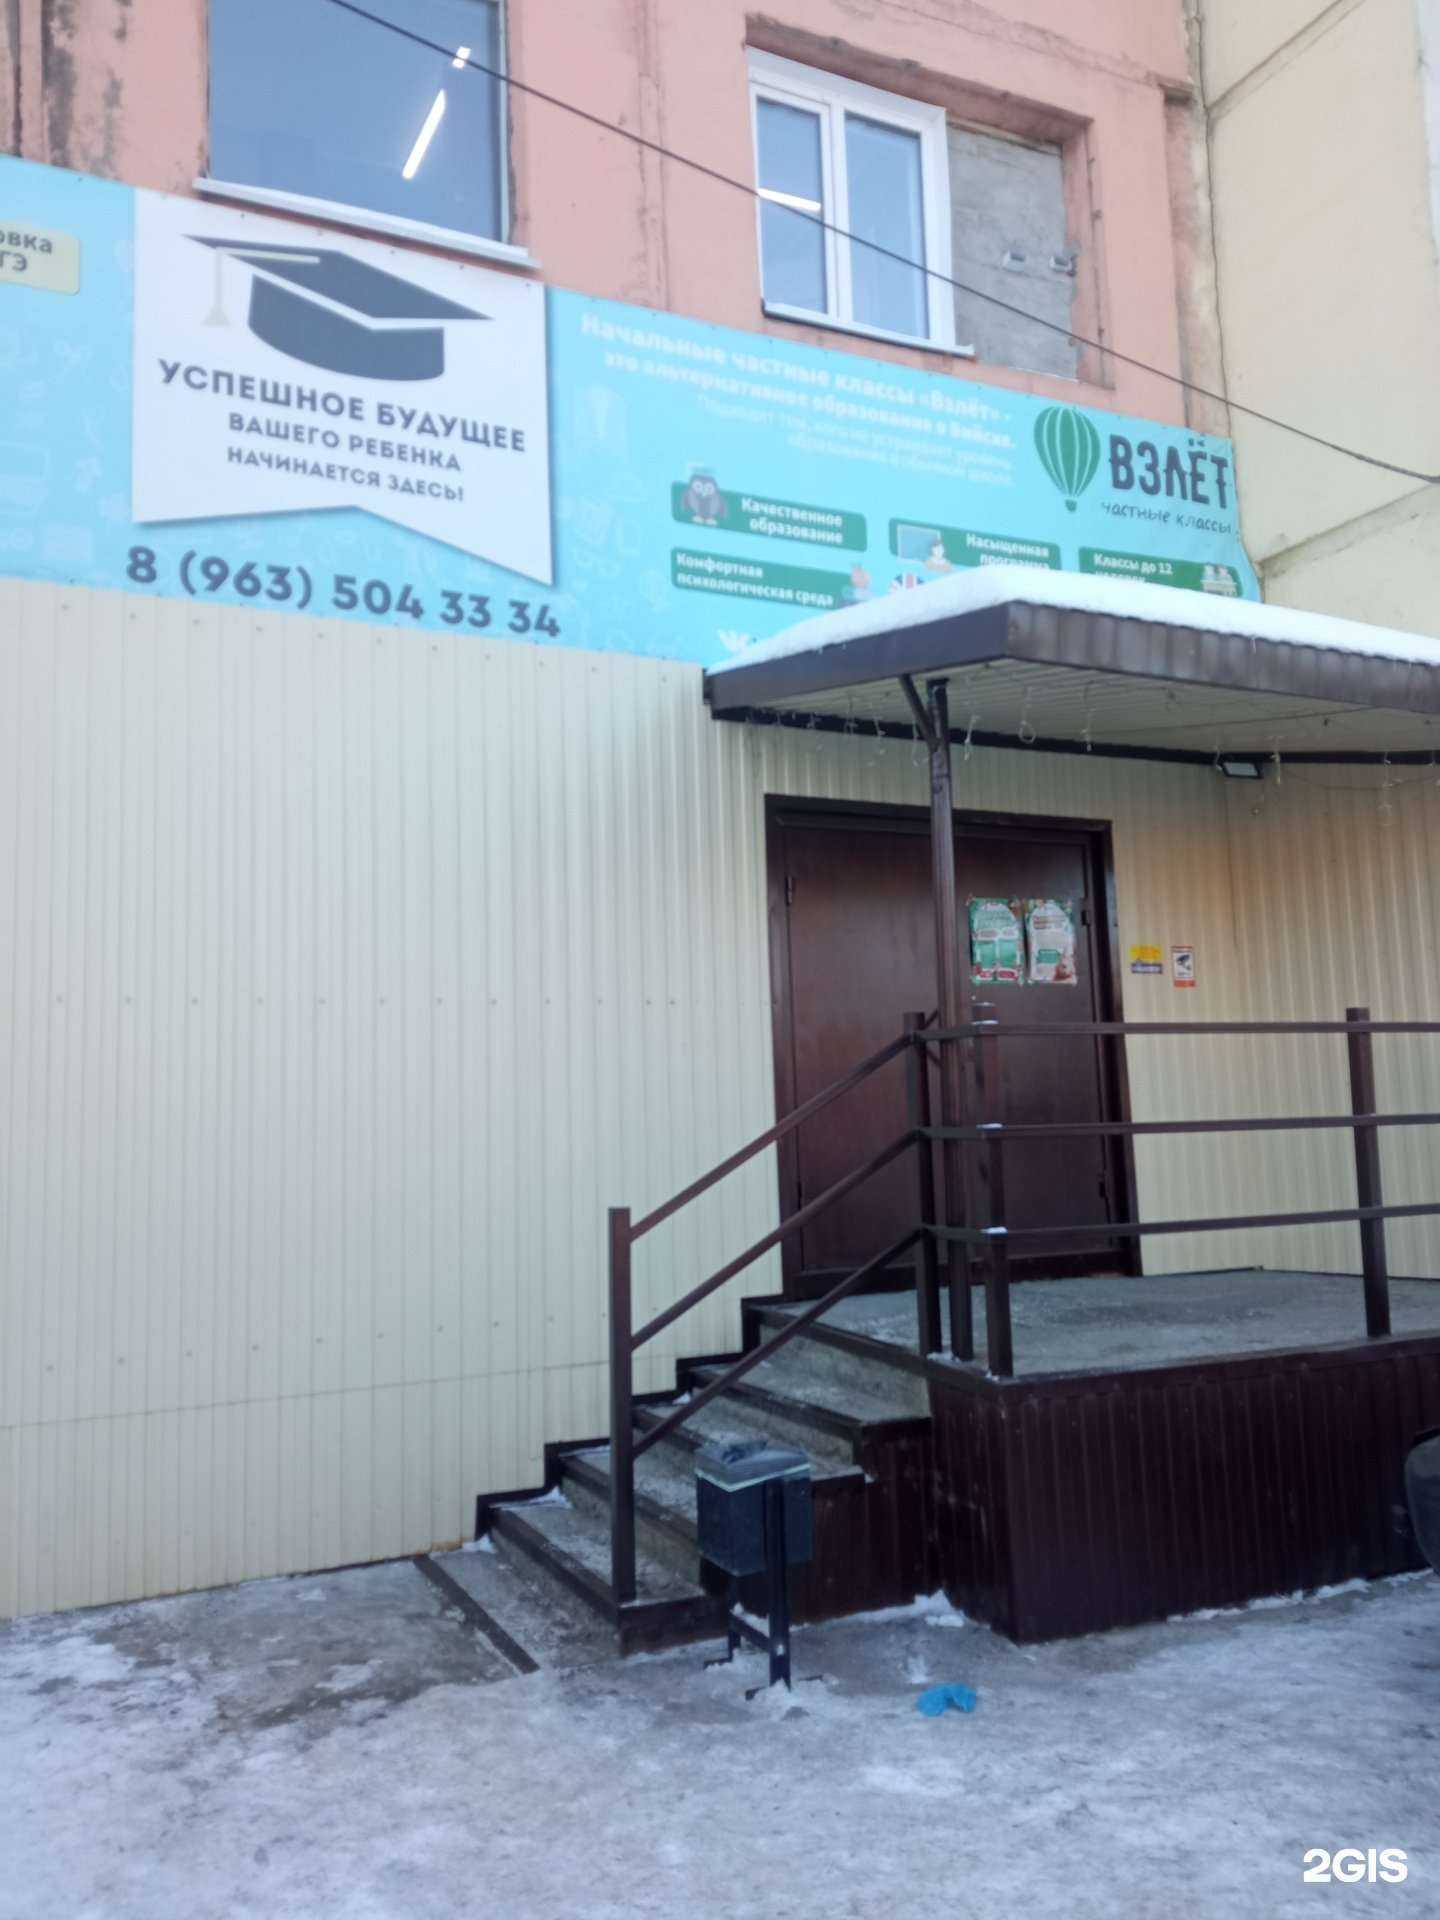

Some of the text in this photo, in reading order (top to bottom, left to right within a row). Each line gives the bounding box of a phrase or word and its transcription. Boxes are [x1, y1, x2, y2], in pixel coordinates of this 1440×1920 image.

[580, 312, 727, 365] Начальные
[731, 352, 832, 387] частные
[834, 372, 914, 405] классы
[157, 358, 527, 453] УСПЕШНОЕ БУДУЩЕЕ
[604, 352, 639, 373] это
[642, 361, 810, 407] альтернативное
[812, 392, 932, 432] образование
[228, 411, 463, 473] ВАШЕГО РЕБЕНКА
[227, 446, 465, 503] НАЧИНАЕТСЯ ЗДЕСЬ!
[1109, 433, 1229, 510] ВЗЛЁТ
[741, 497, 844, 528] Качественное
[749, 518, 844, 545] образование
[1101, 501, 1233, 535] частные классы
[675, 552, 764, 579] Комфортная
[965, 532, 1050, 559] Насыщенная
[1093, 552, 1173, 575] Классы до 12
[126, 545, 562, 638] 8 (963) 504 33 34
[676, 572, 834, 607] психологическая среда
